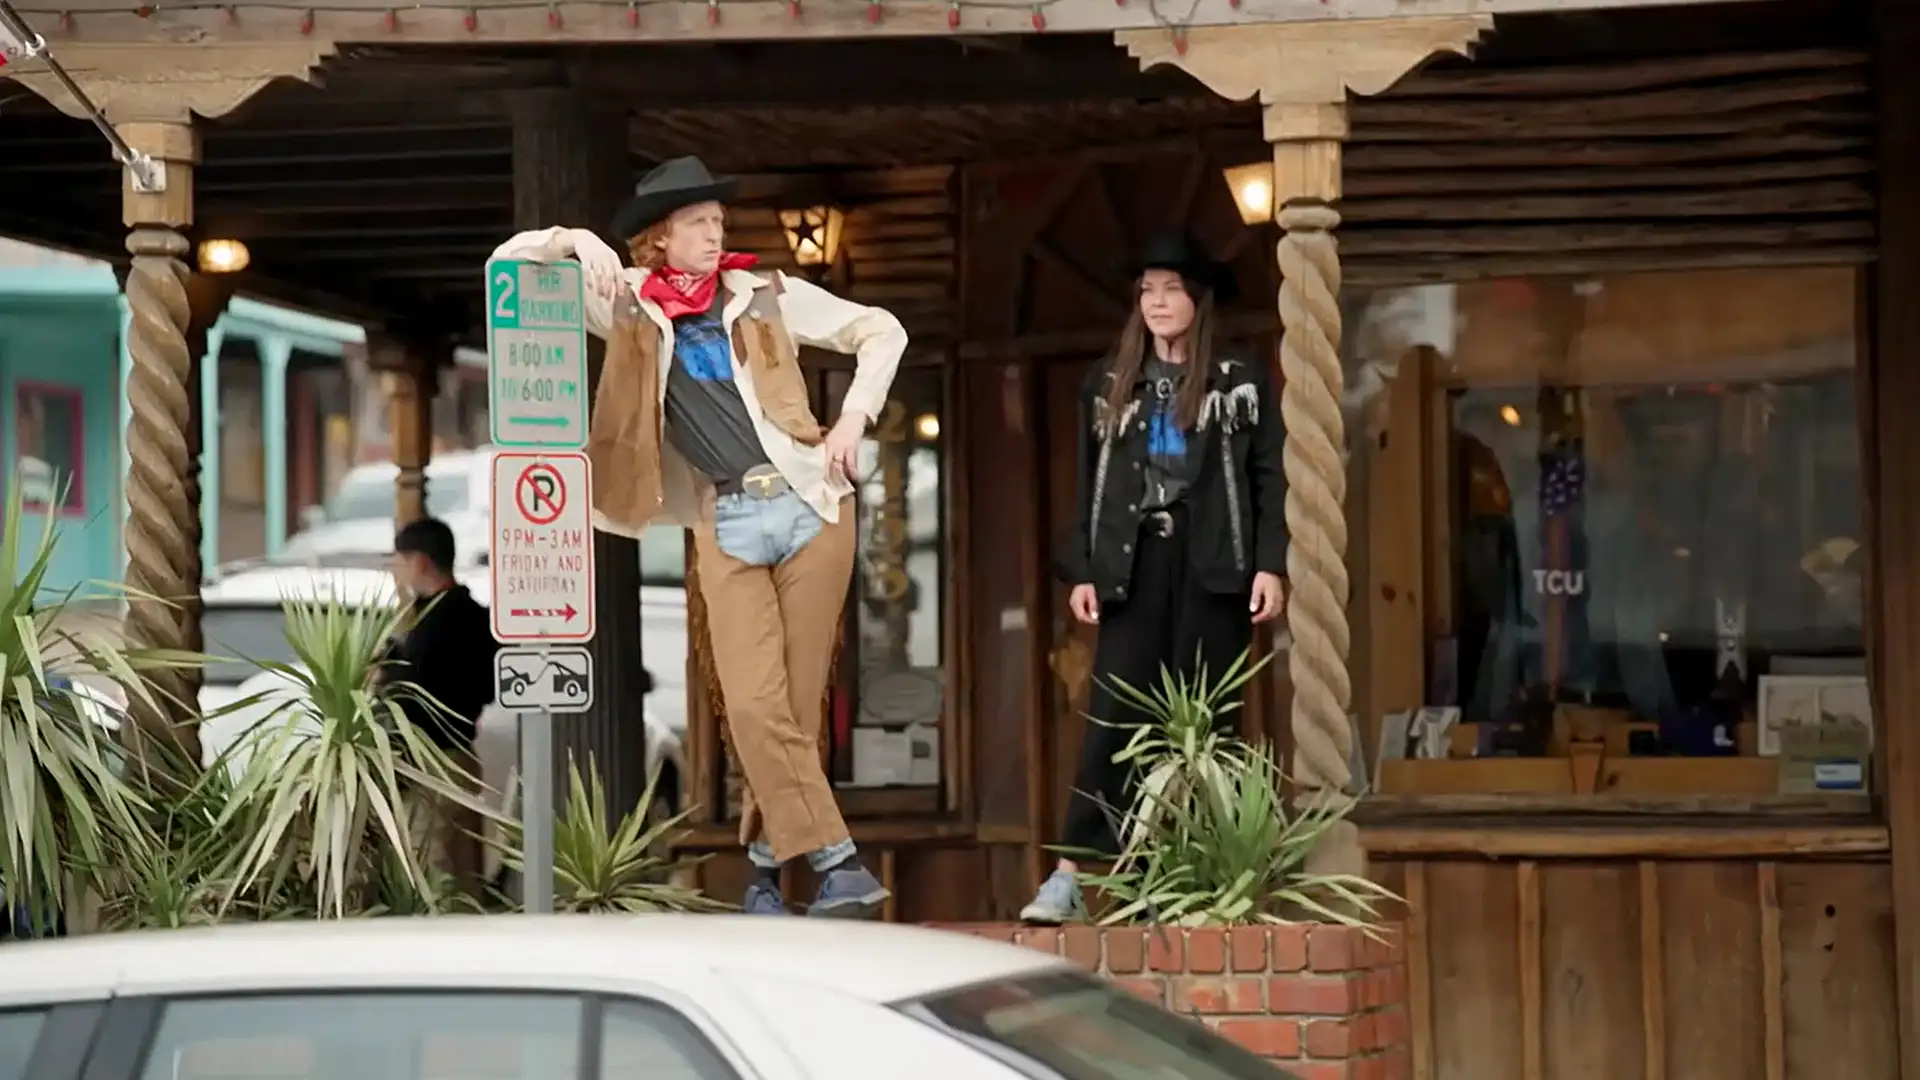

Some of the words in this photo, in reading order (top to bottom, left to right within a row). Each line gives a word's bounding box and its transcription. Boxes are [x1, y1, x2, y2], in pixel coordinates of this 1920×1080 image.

[494, 271, 515, 318] 2
[502, 554, 549, 573] FRIDAY
[558, 555, 583, 573] AND
[508, 576, 576, 594] SATURDAY
[1532, 568, 1584, 595] TCU
